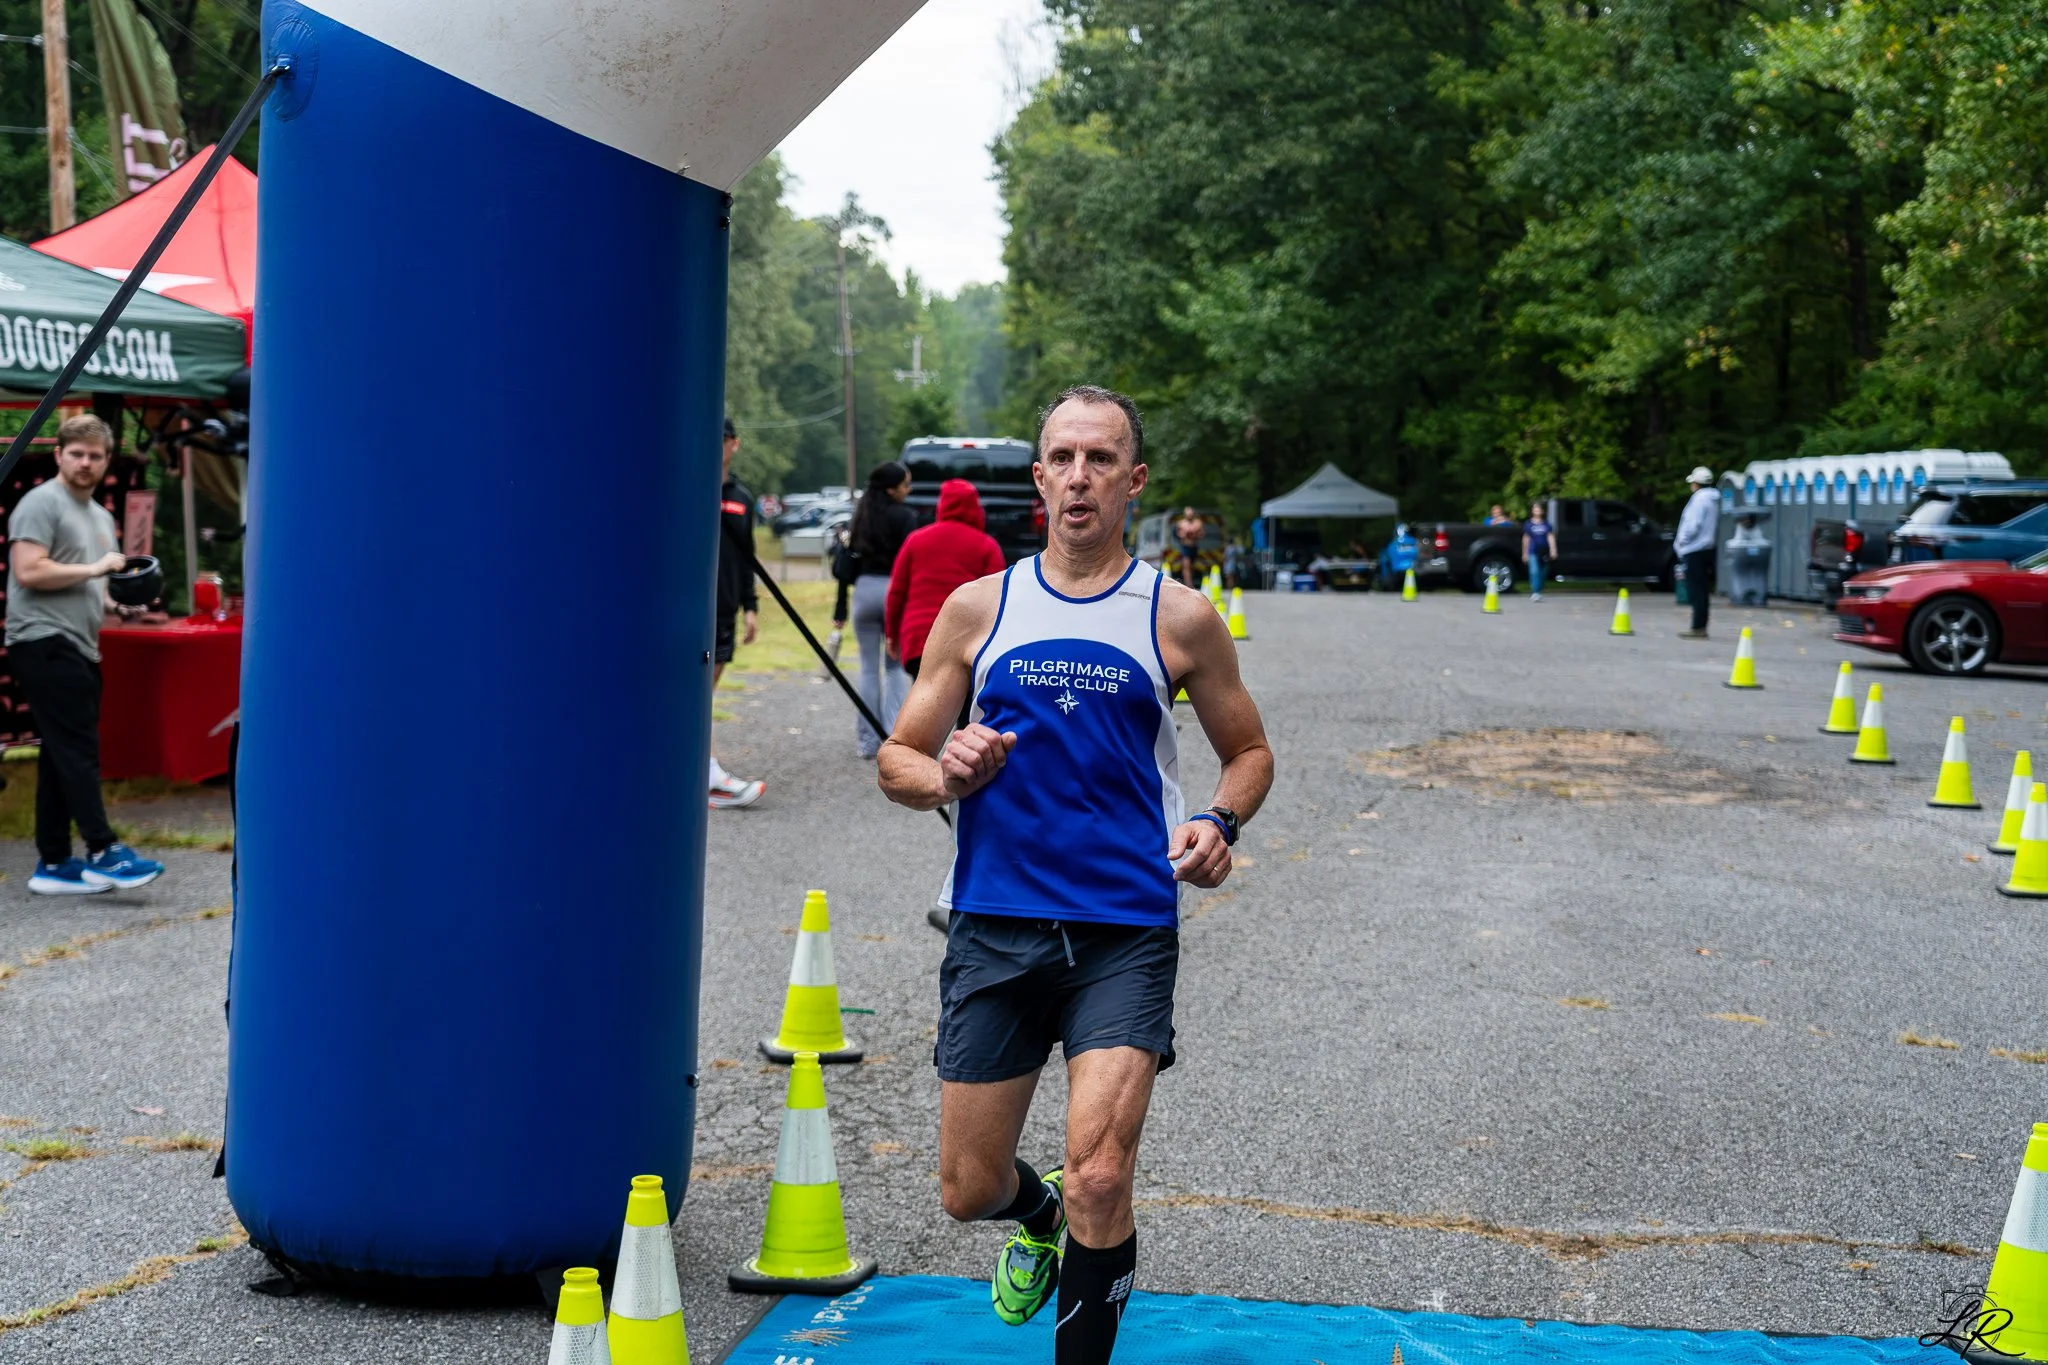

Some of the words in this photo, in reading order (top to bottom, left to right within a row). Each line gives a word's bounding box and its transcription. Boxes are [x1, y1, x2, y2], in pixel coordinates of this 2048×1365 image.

[1009, 659, 1130, 683] PILGRIMAGE
[1017, 675, 1070, 688] TRACK
[1074, 678, 1119, 694] CLUB
